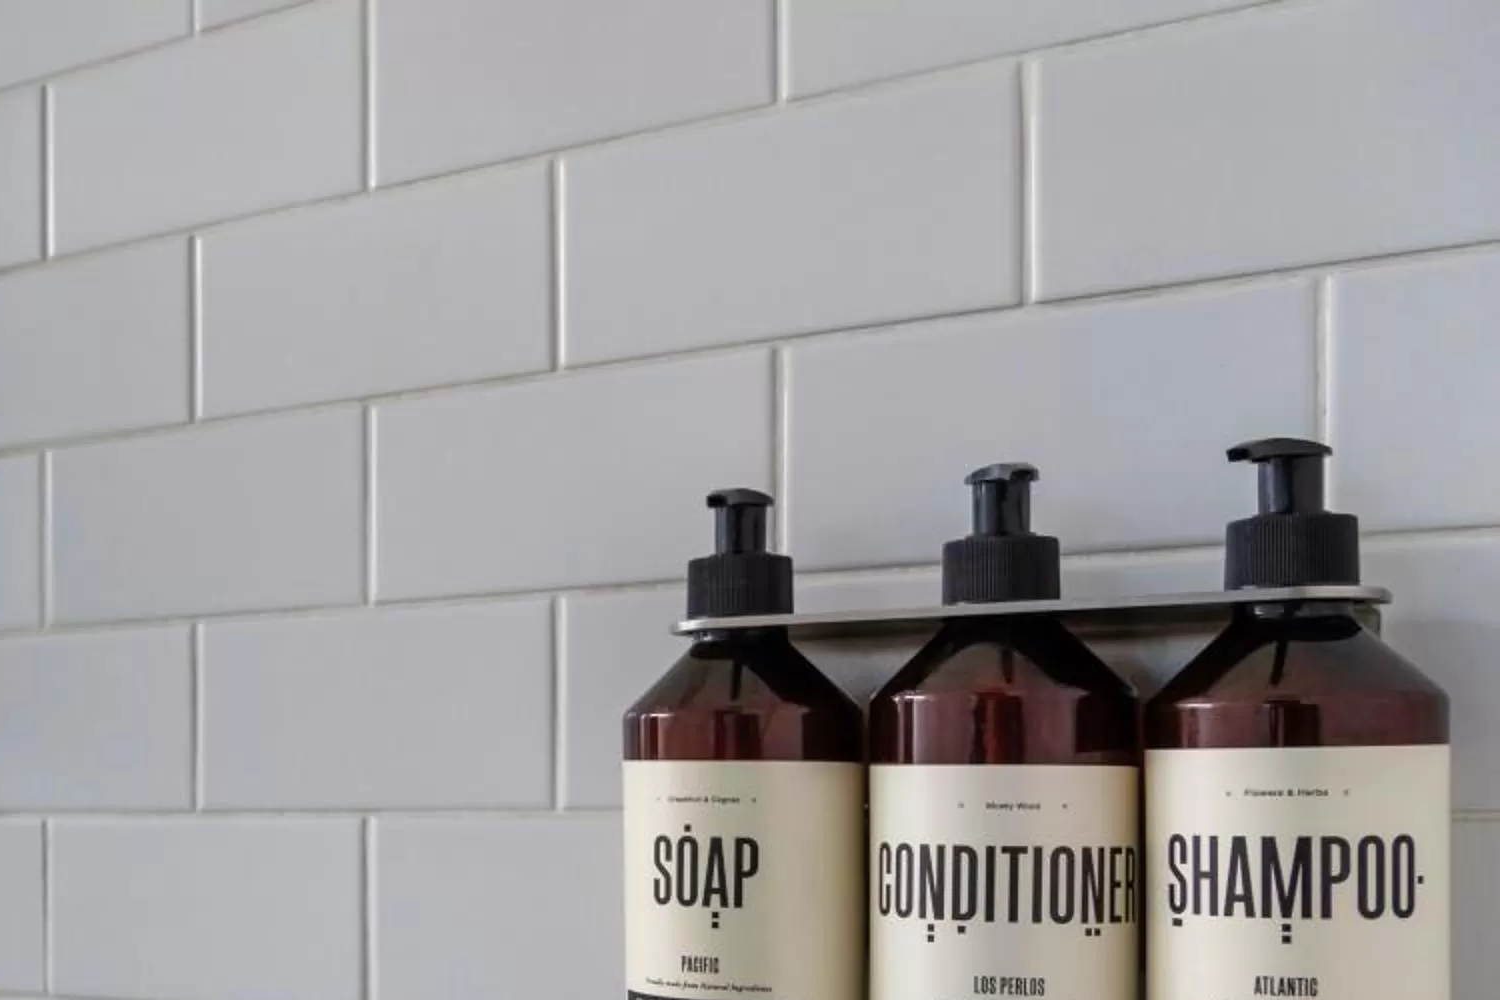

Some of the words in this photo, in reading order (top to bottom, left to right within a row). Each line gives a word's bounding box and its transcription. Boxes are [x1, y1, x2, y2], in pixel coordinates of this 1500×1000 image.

[653, 834, 760, 909] SOAP
[879, 841, 1137, 925] CONDITIONER
[1168, 833, 1416, 920] SHAMPOO
[681, 955, 720, 974] PACIFIC
[973, 975, 997, 995] LOS
[999, 976, 1045, 997] PERLOS
[1253, 975, 1319, 997] ATLANTIC
